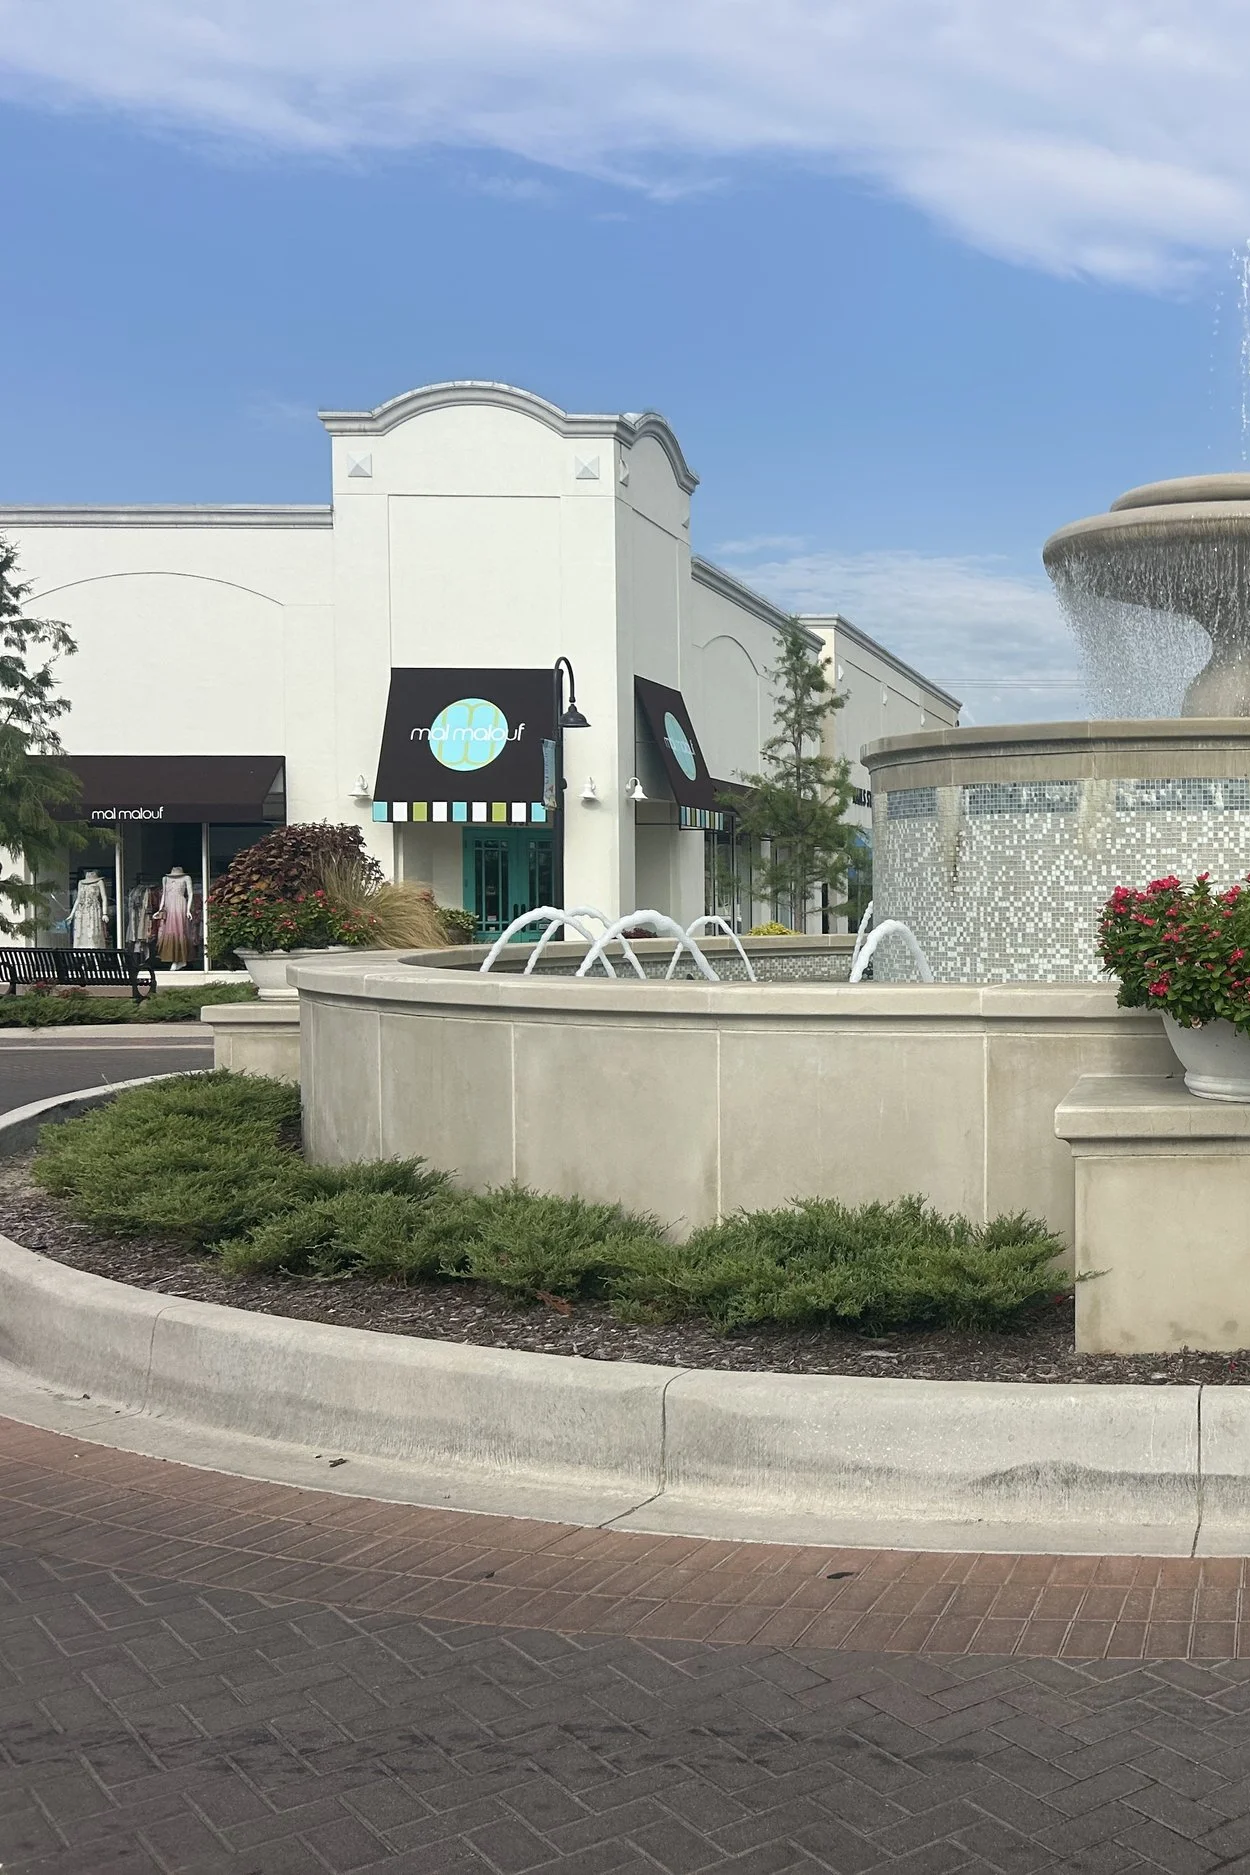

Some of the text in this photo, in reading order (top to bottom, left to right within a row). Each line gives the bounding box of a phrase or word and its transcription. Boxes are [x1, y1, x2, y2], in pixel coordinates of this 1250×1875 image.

[410, 723, 526, 742] mal malouf
[91, 806, 164, 820] mal malouf
